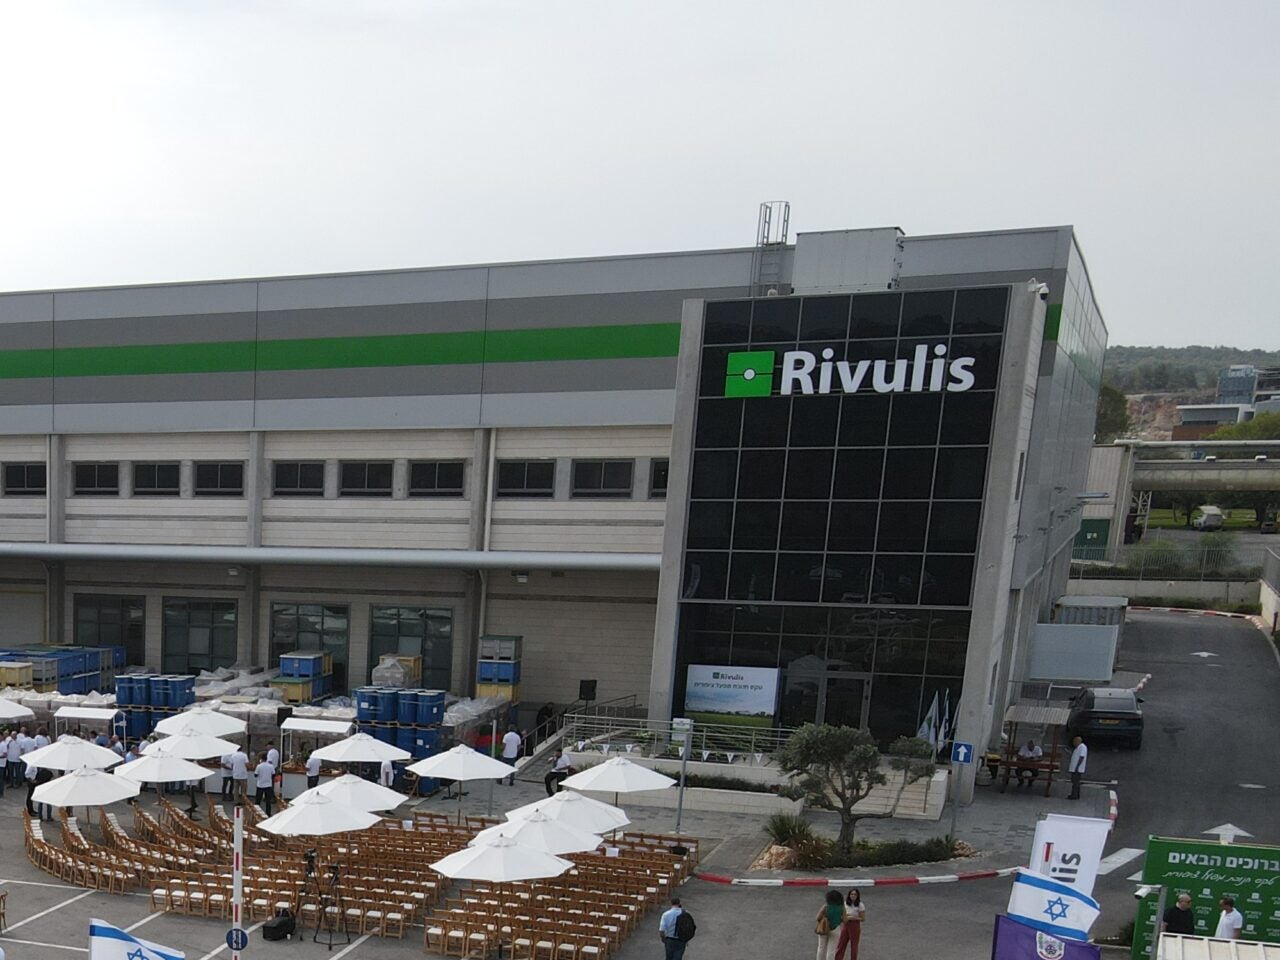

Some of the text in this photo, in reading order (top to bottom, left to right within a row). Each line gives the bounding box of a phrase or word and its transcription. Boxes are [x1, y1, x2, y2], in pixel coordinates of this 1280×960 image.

[780, 343, 976, 396] Rivulis
[1168, 852, 1280, 872] ברוכים הבאים
